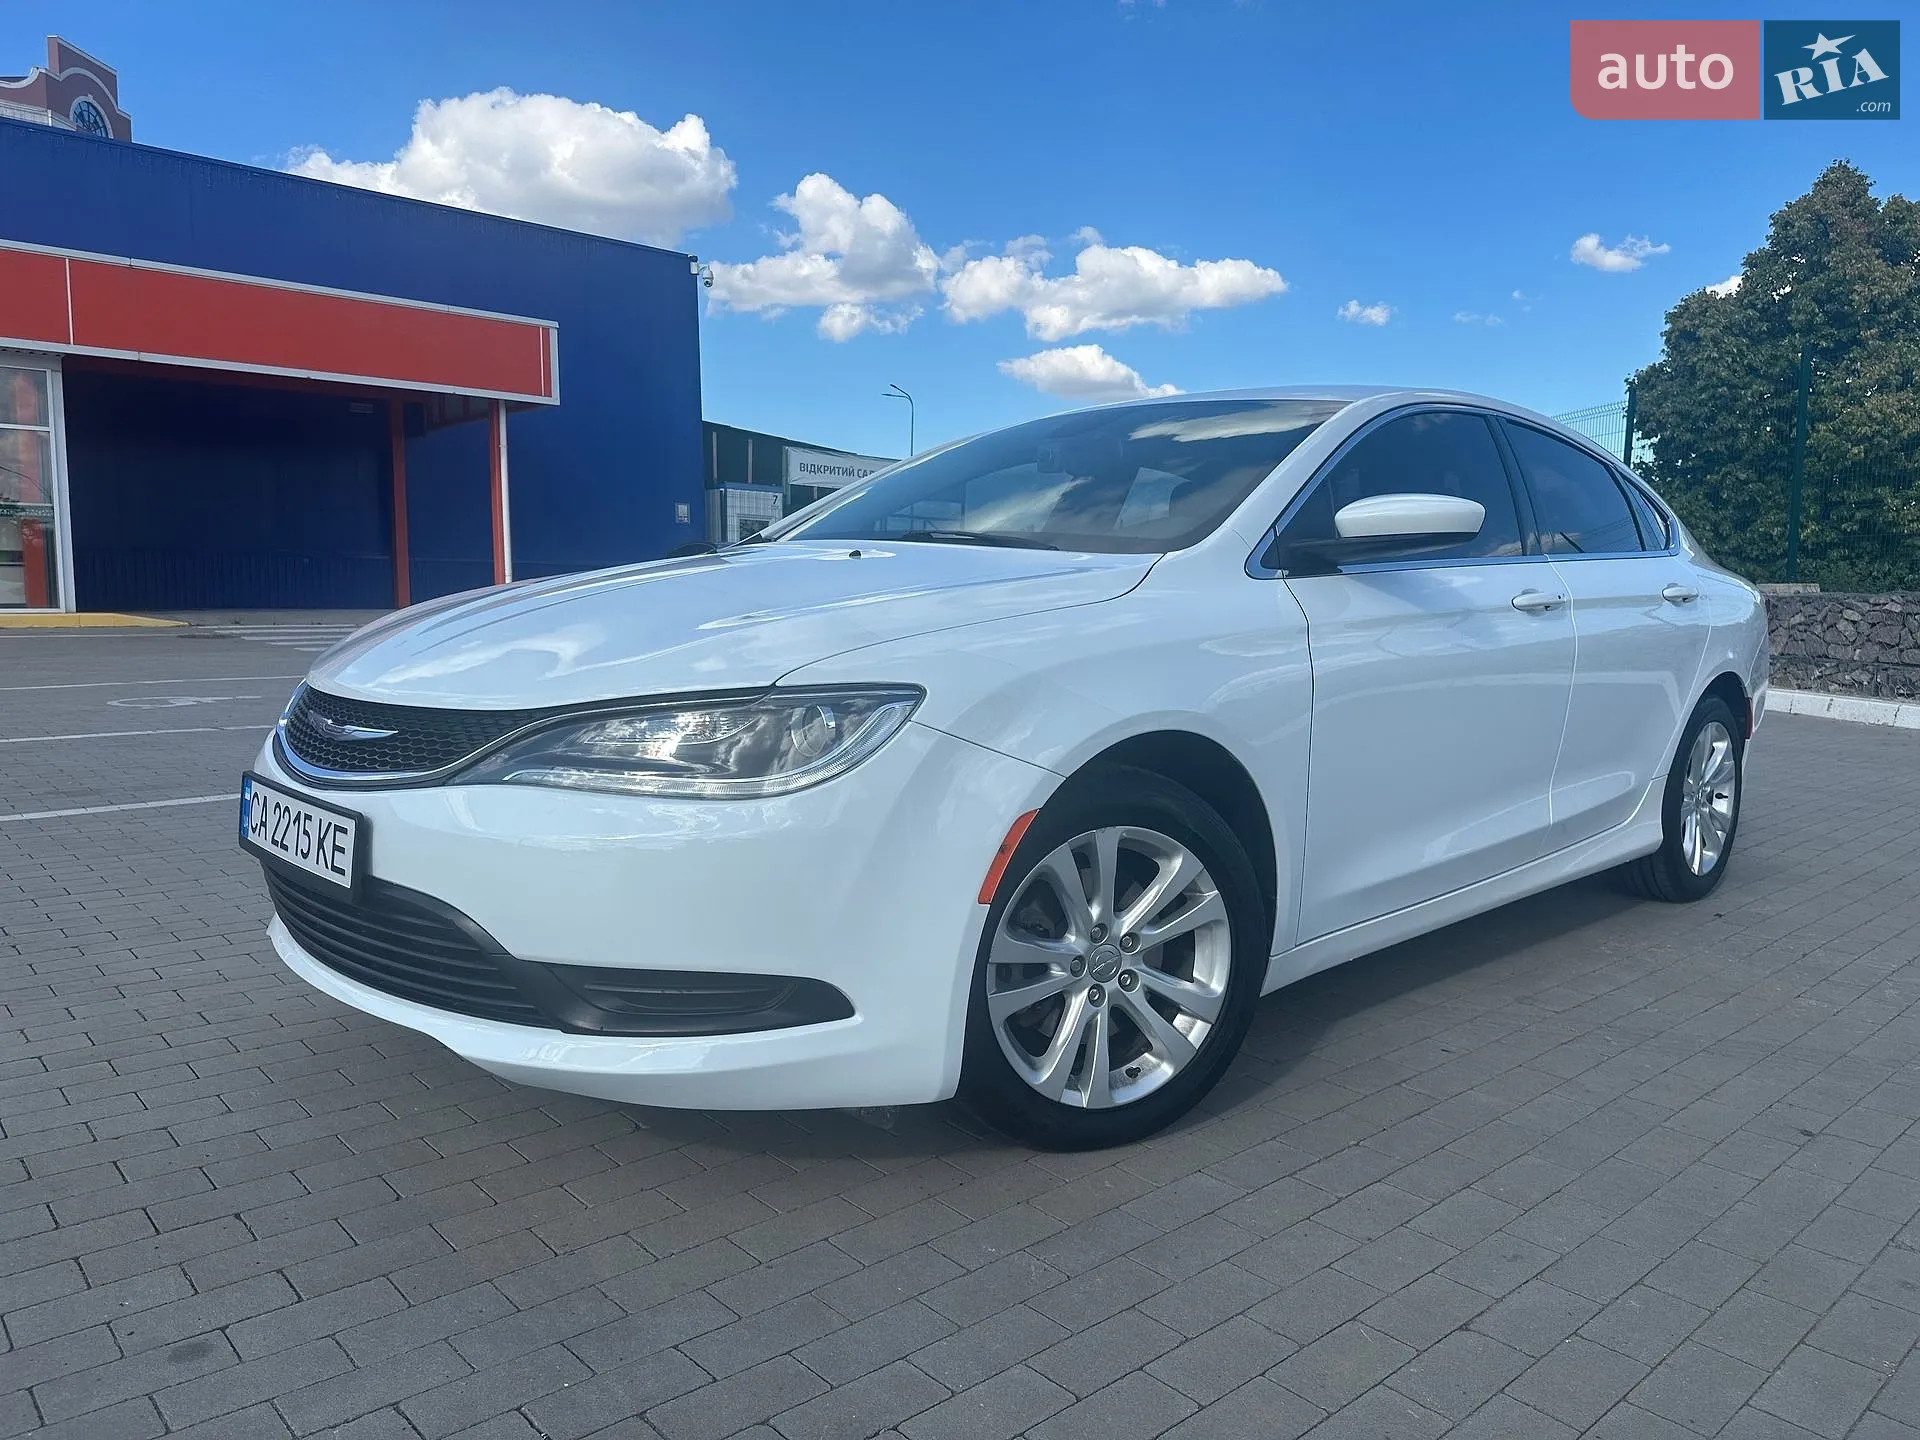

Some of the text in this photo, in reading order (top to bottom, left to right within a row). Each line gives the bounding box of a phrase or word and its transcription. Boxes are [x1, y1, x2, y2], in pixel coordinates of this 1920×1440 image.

[799, 462, 855, 477] ВІДКРИТИЙ
[773, 495, 778, 504] 7
[250, 791, 348, 877] CA 2215 KE
